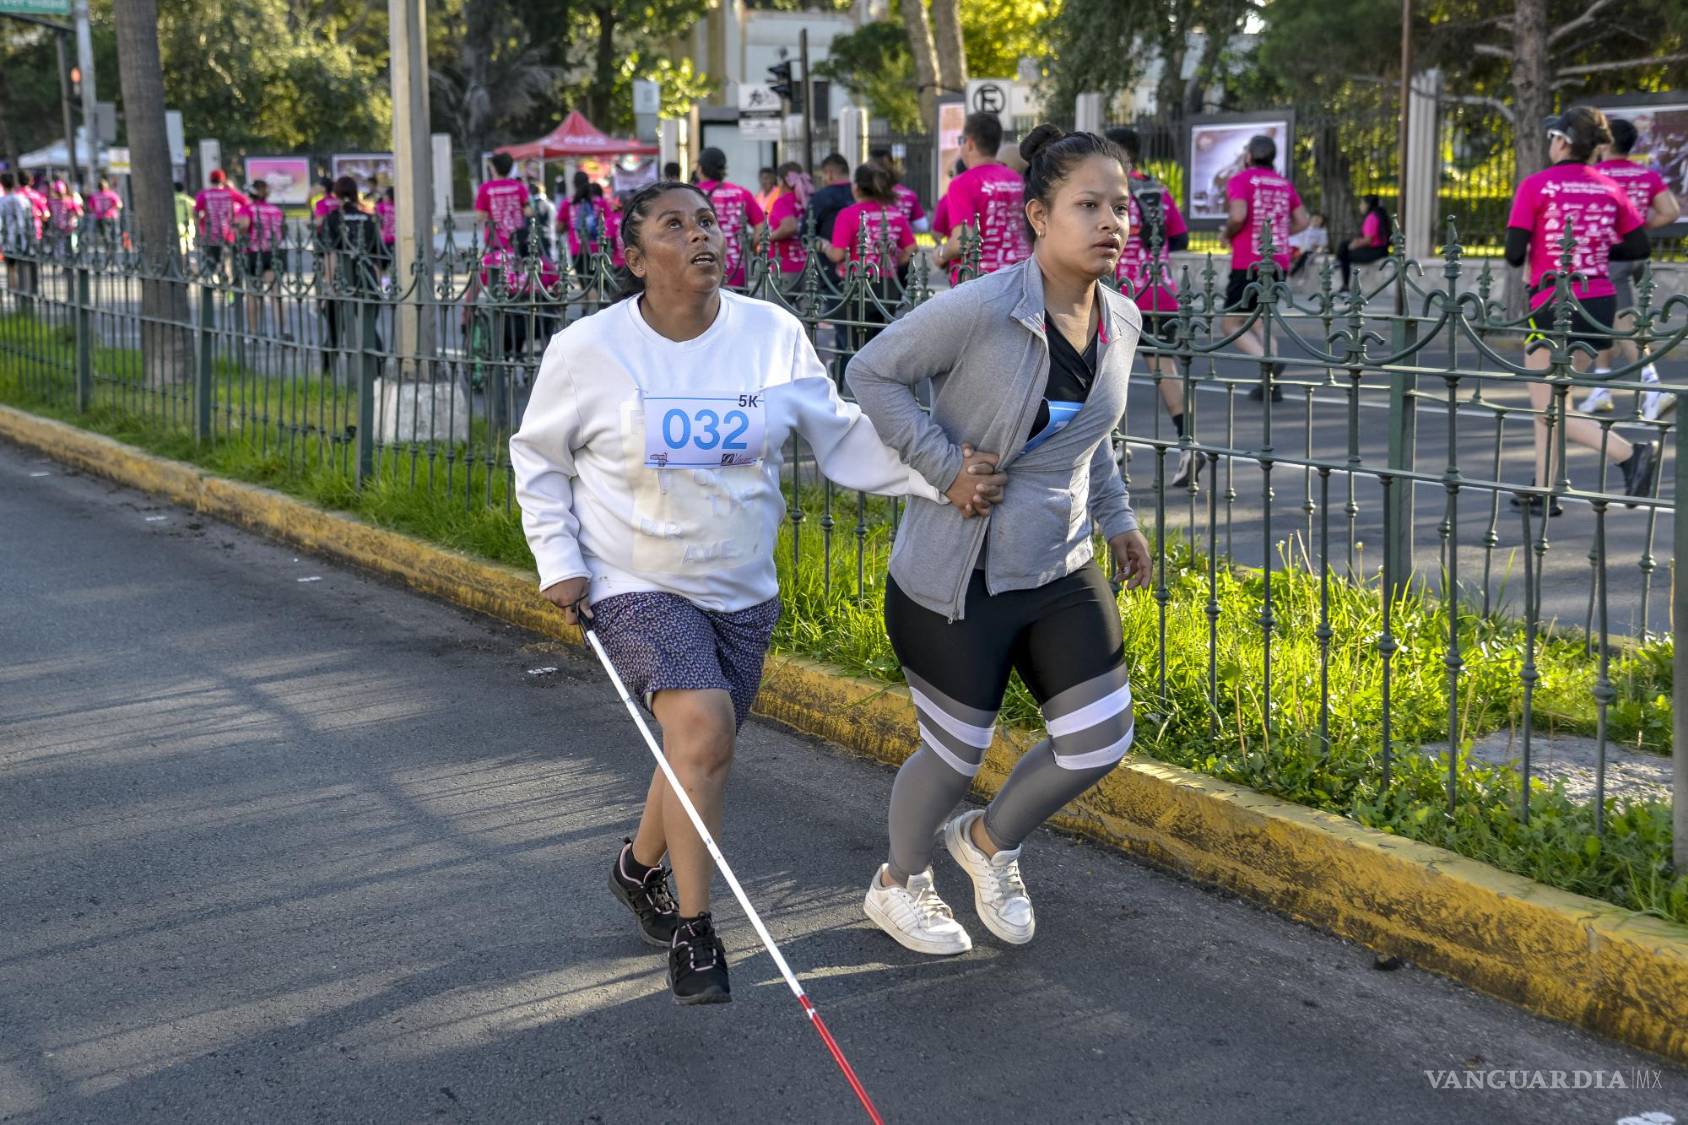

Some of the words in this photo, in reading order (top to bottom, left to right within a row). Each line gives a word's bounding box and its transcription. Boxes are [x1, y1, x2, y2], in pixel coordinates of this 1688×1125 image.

[980, 88, 1000, 113] E
[738, 394, 758, 408] 5K
[662, 408, 749, 450] 032
